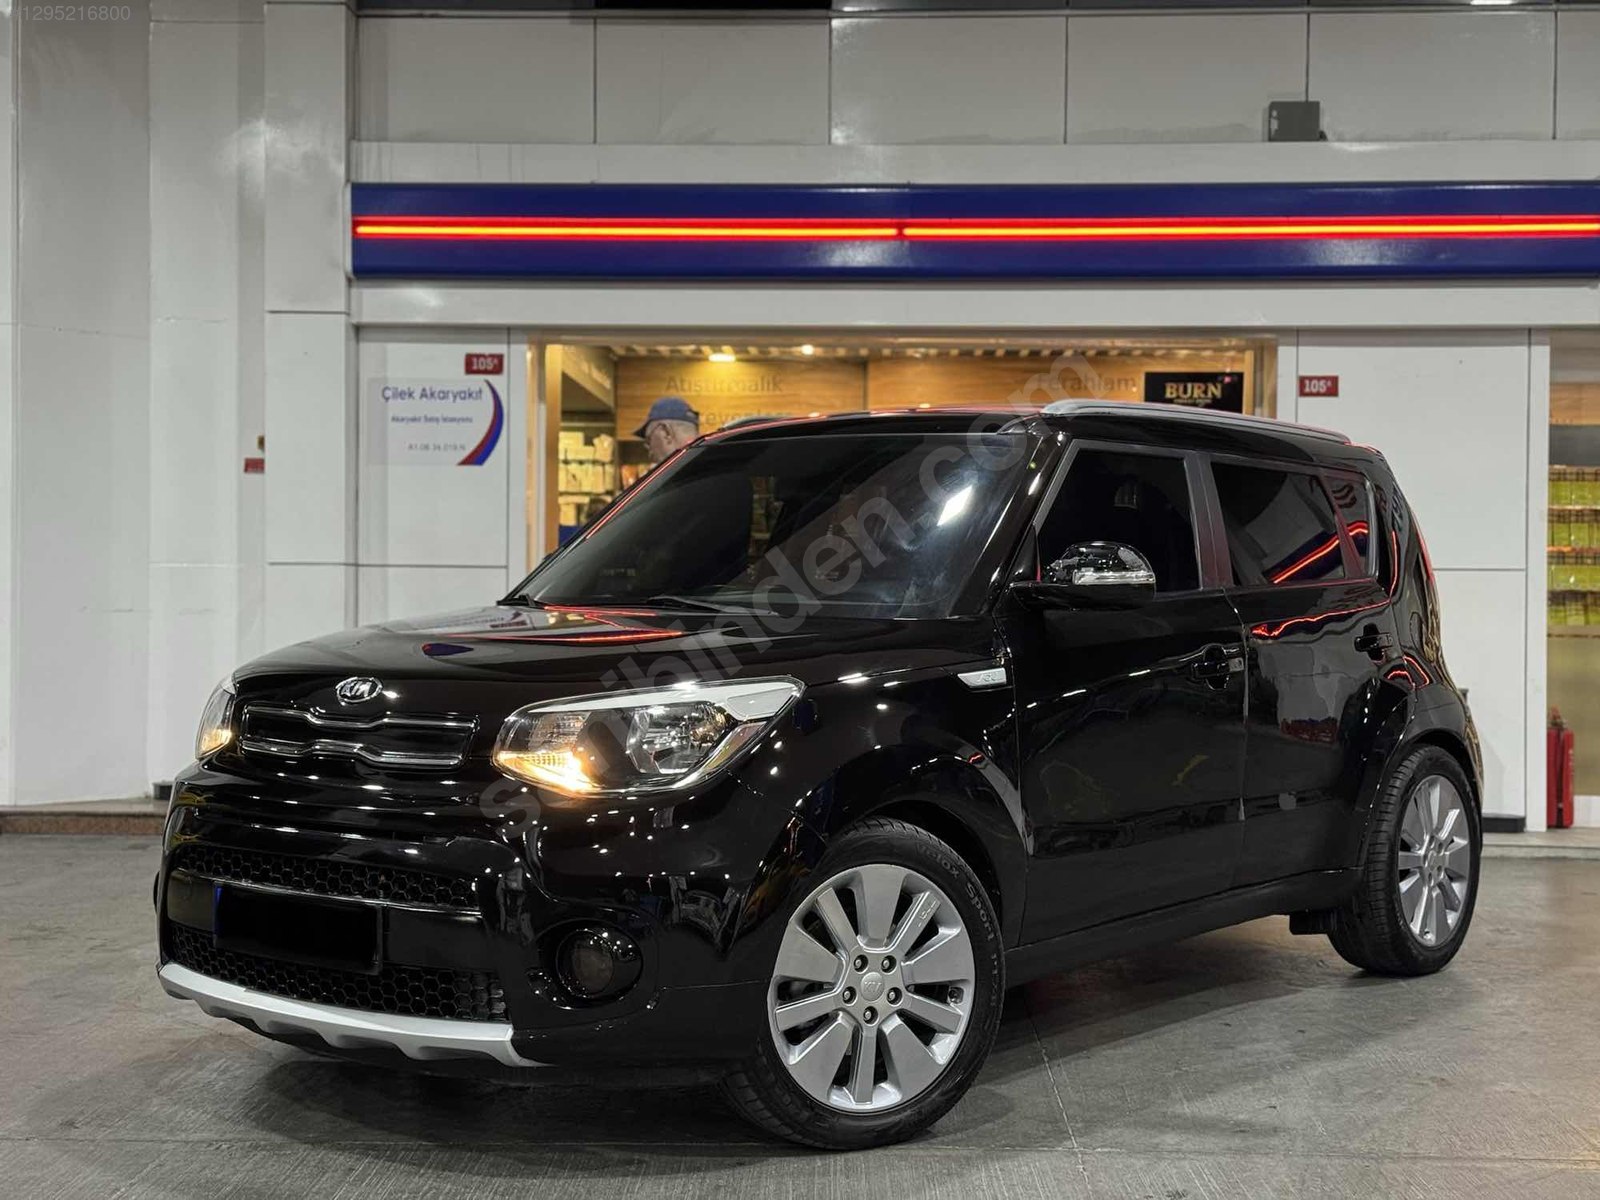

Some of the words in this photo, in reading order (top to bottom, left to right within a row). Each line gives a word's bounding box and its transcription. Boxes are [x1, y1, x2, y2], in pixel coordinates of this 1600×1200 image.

[381, 386, 415, 402] Çilek
[419, 387, 482, 402] Akaryakıt
[1165, 383, 1222, 398] BURN
